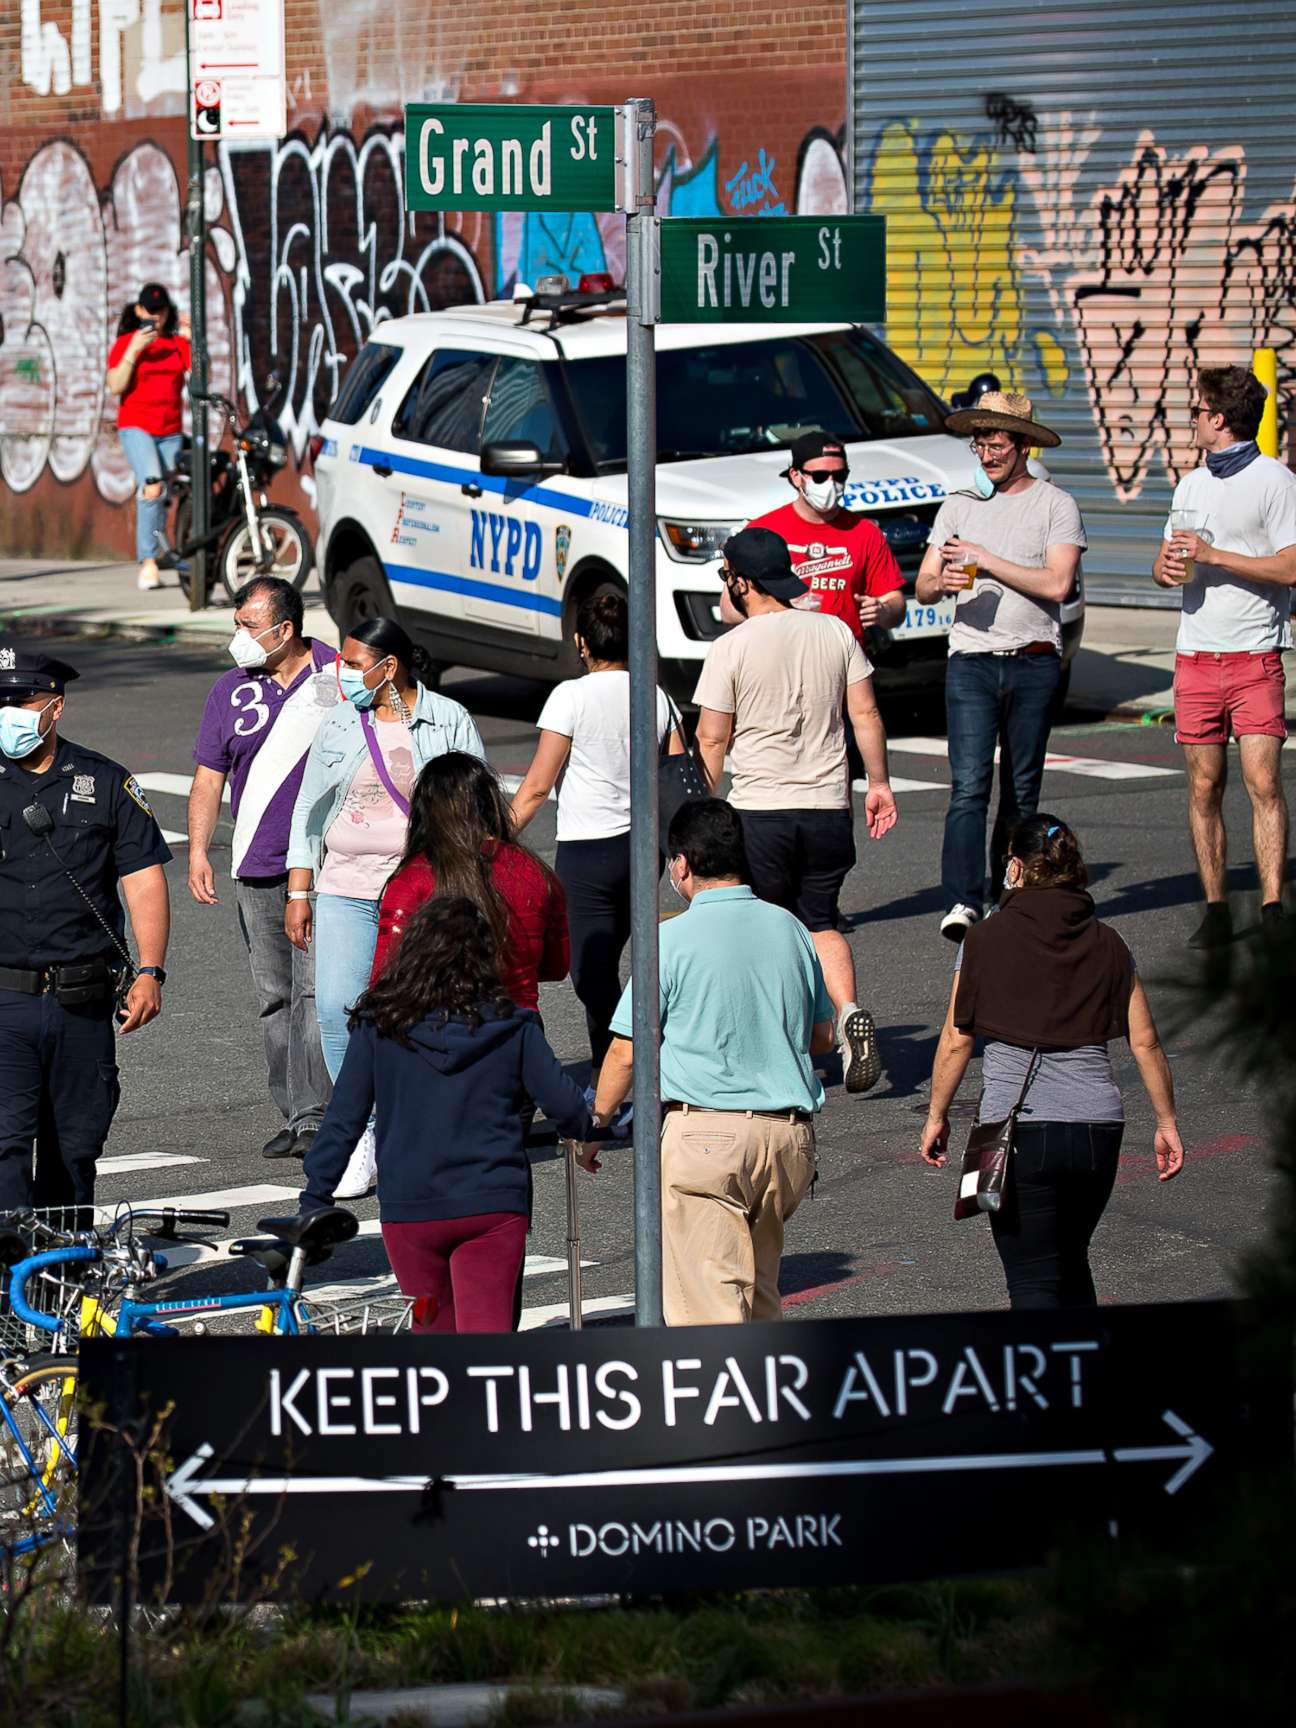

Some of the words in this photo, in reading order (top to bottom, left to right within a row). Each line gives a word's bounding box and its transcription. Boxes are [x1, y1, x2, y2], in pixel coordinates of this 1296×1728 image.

[419, 117, 552, 196] Grand
[570, 115, 598, 161] St
[697, 232, 796, 308] River
[817, 226, 842, 270] St
[841, 483, 947, 508] POLICE
[469, 508, 543, 581] NYPD
[811, 577, 847, 591] BEER
[896, 607, 936, 628] 179
[230, 681, 270, 737] 3
[270, 1366, 450, 1436] KEEP
[466, 1360, 642, 1433] THIS
[661, 1354, 811, 1427] FAR
[834, 1341, 1098, 1418] APART
[568, 1517, 736, 1558] DOMINO
[746, 1514, 843, 1550] PARK
